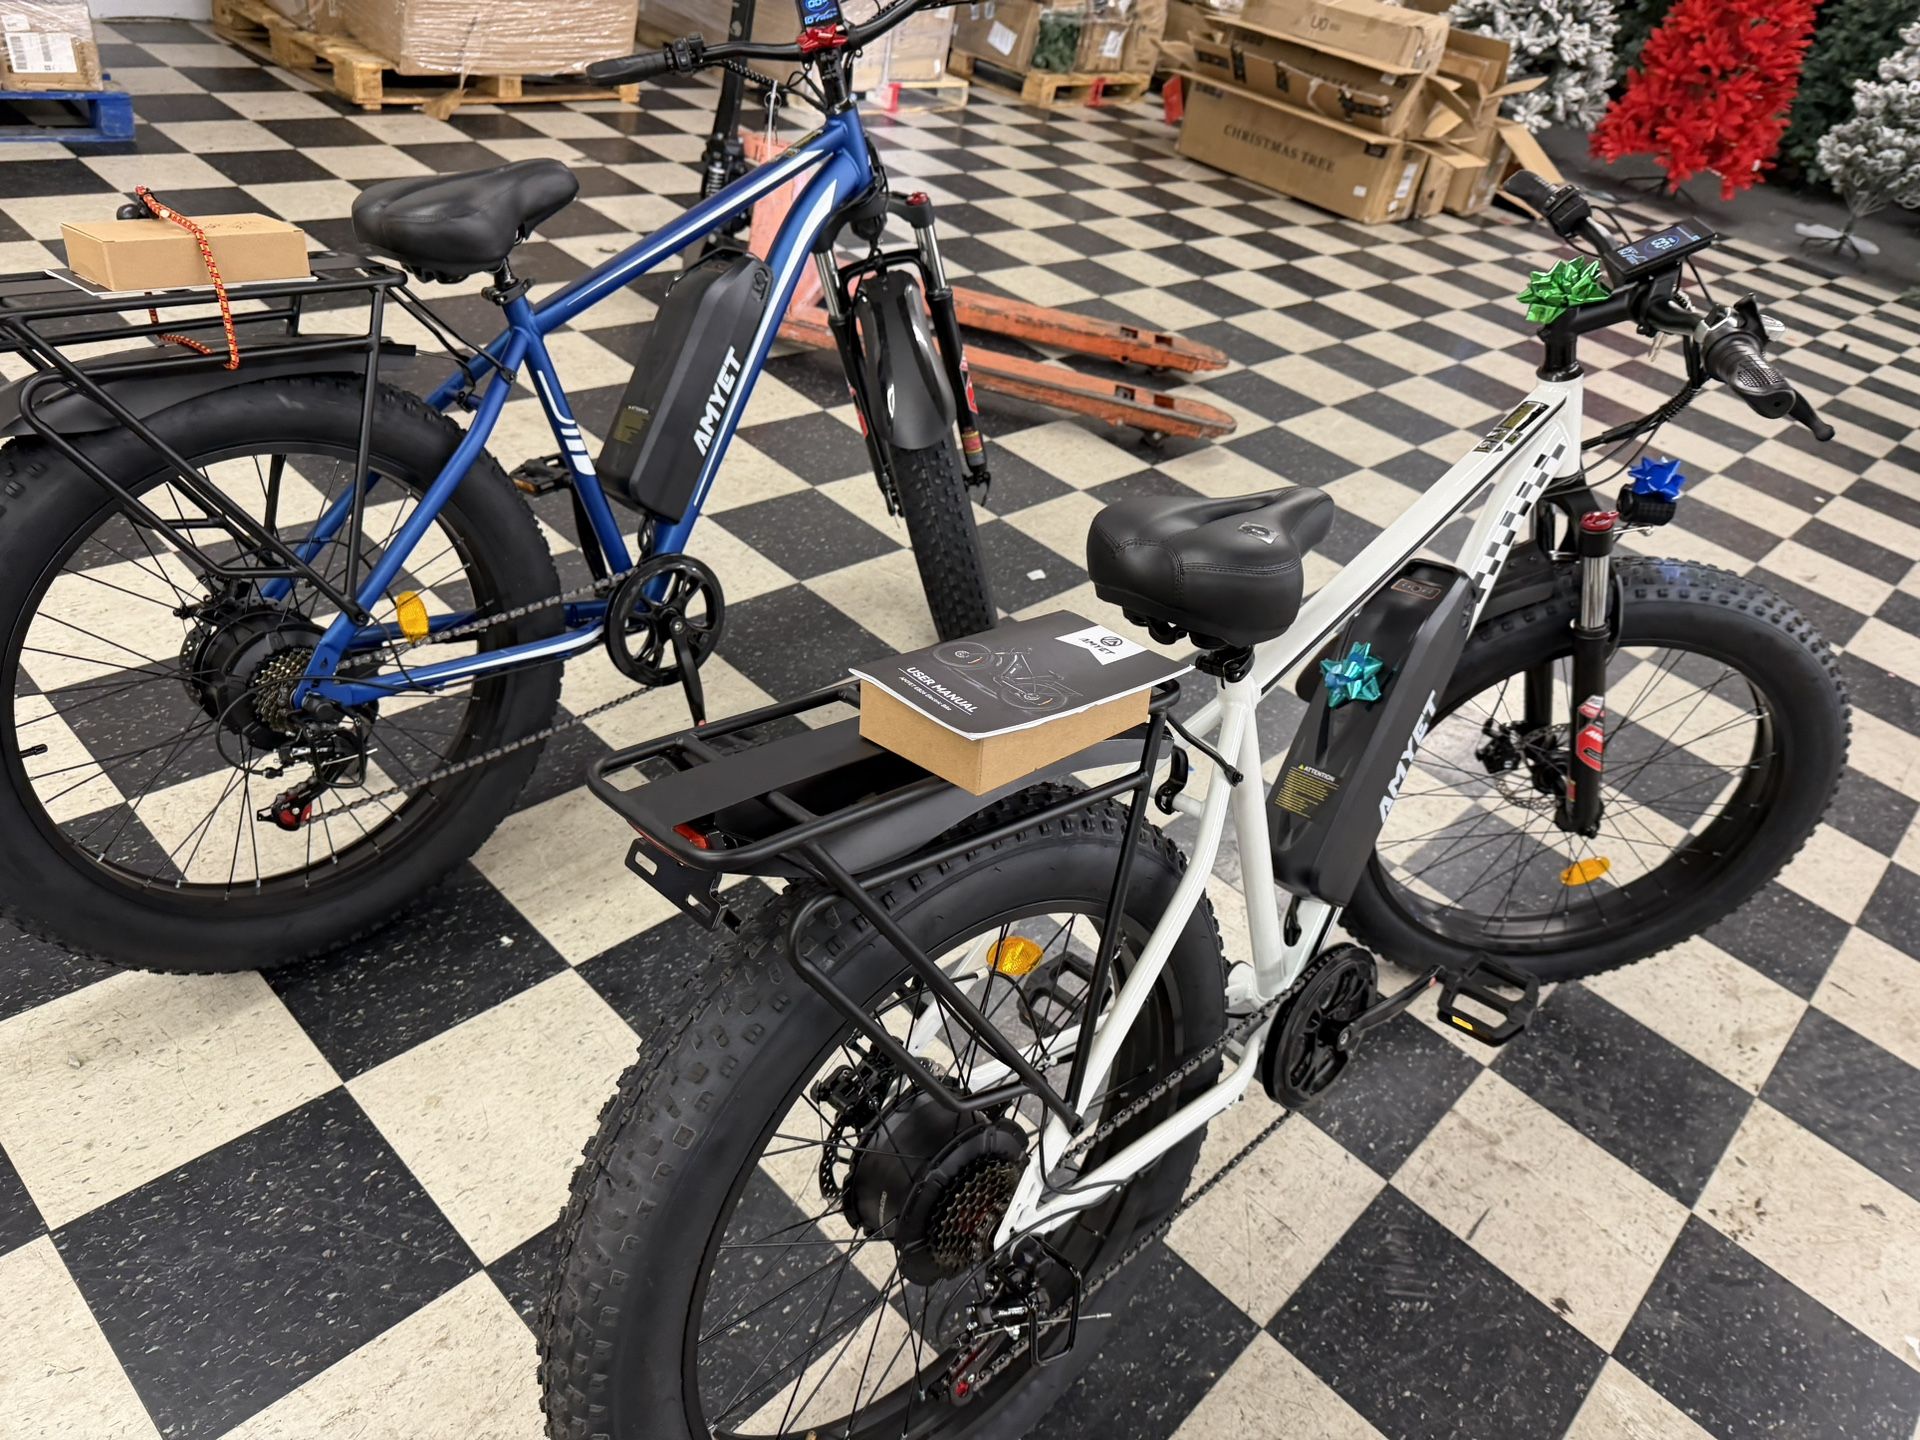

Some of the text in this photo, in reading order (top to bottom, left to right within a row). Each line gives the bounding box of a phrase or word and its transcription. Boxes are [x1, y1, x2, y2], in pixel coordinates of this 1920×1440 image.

[1223, 124, 1298, 159] CHRISTMAS
[1301, 151, 1336, 174] TREE
[693, 345, 741, 457] AMYET
[906, 666, 978, 713] USER MANUAL
[1304, 766, 1336, 782] ATTENTION
